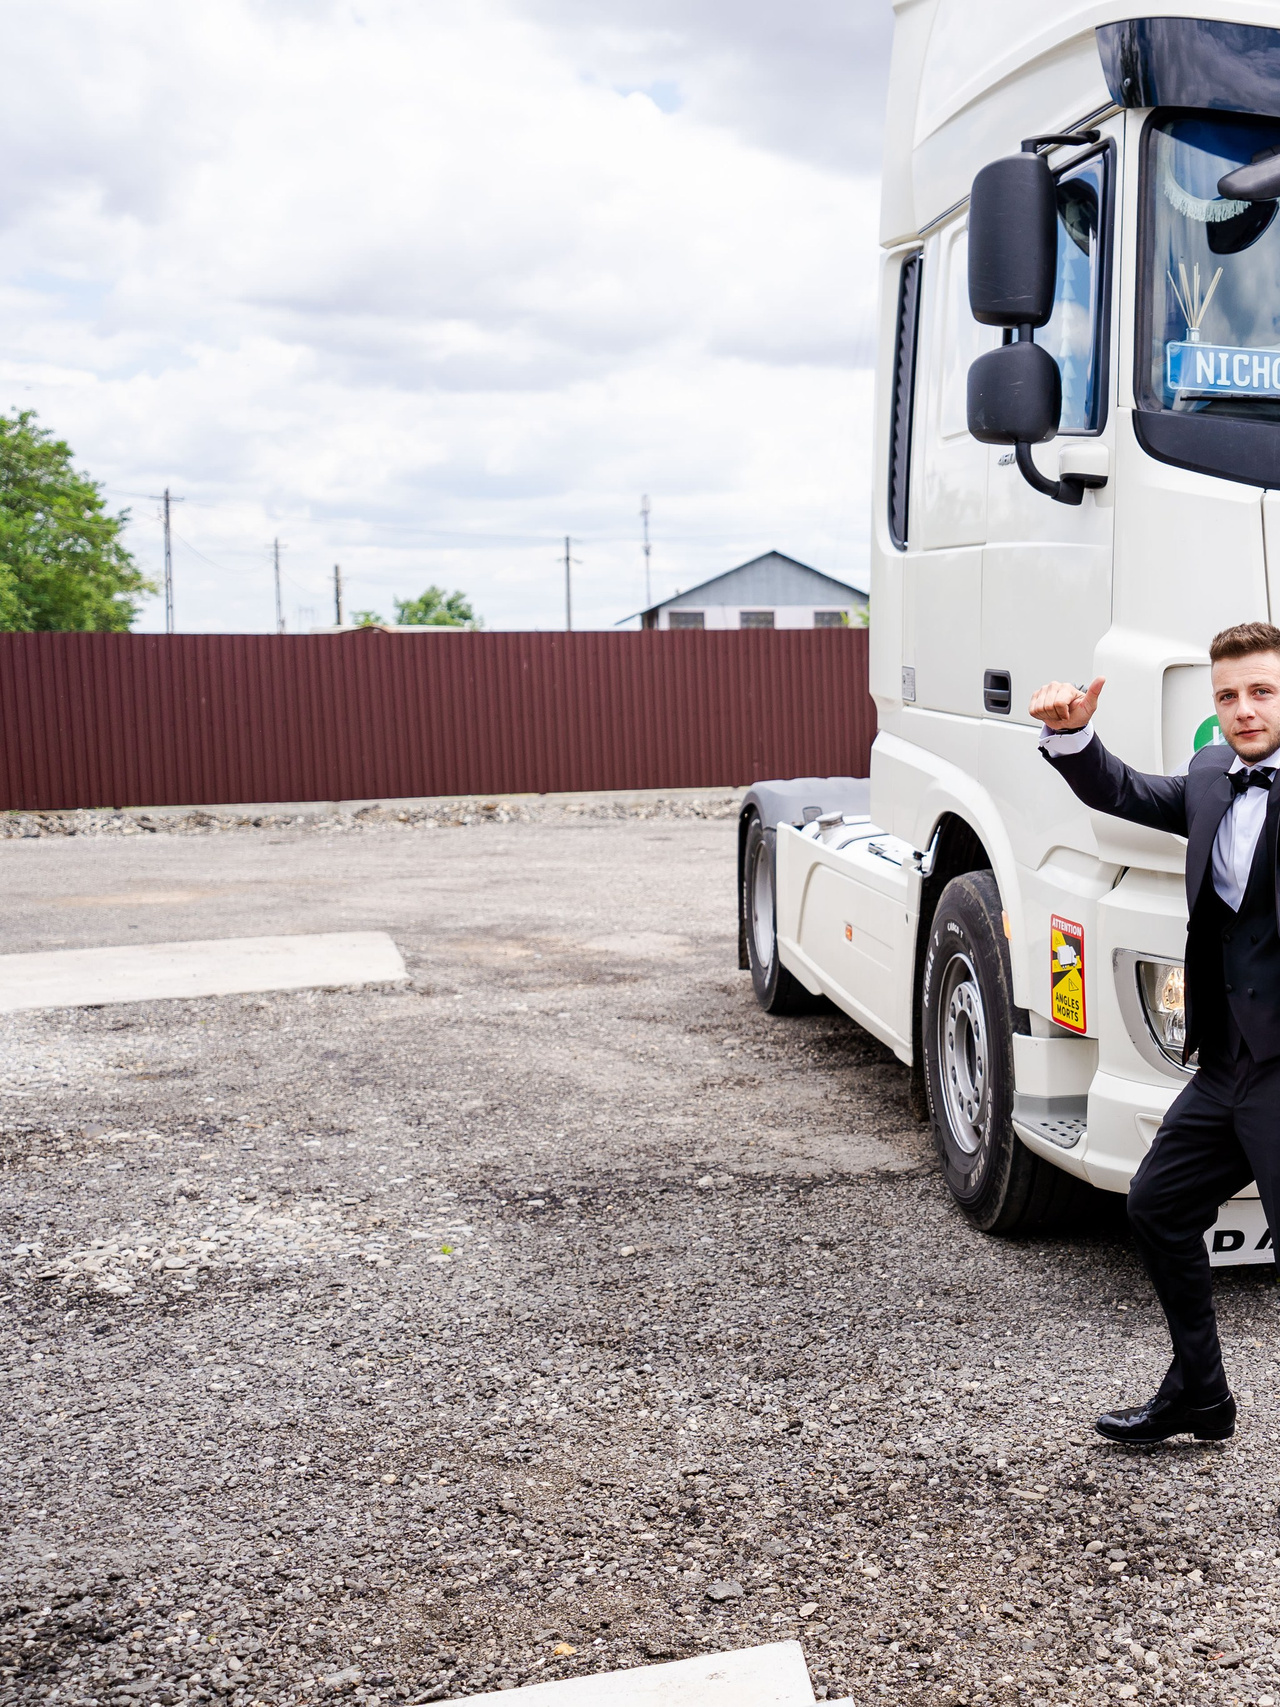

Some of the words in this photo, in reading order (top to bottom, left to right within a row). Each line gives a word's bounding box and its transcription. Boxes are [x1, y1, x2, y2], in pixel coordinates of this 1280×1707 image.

[1052, 917, 1082, 937] ATTENTION
[1055, 992, 1080, 1011] ANGLES
[1056, 1003, 1079, 1022] MORTS
